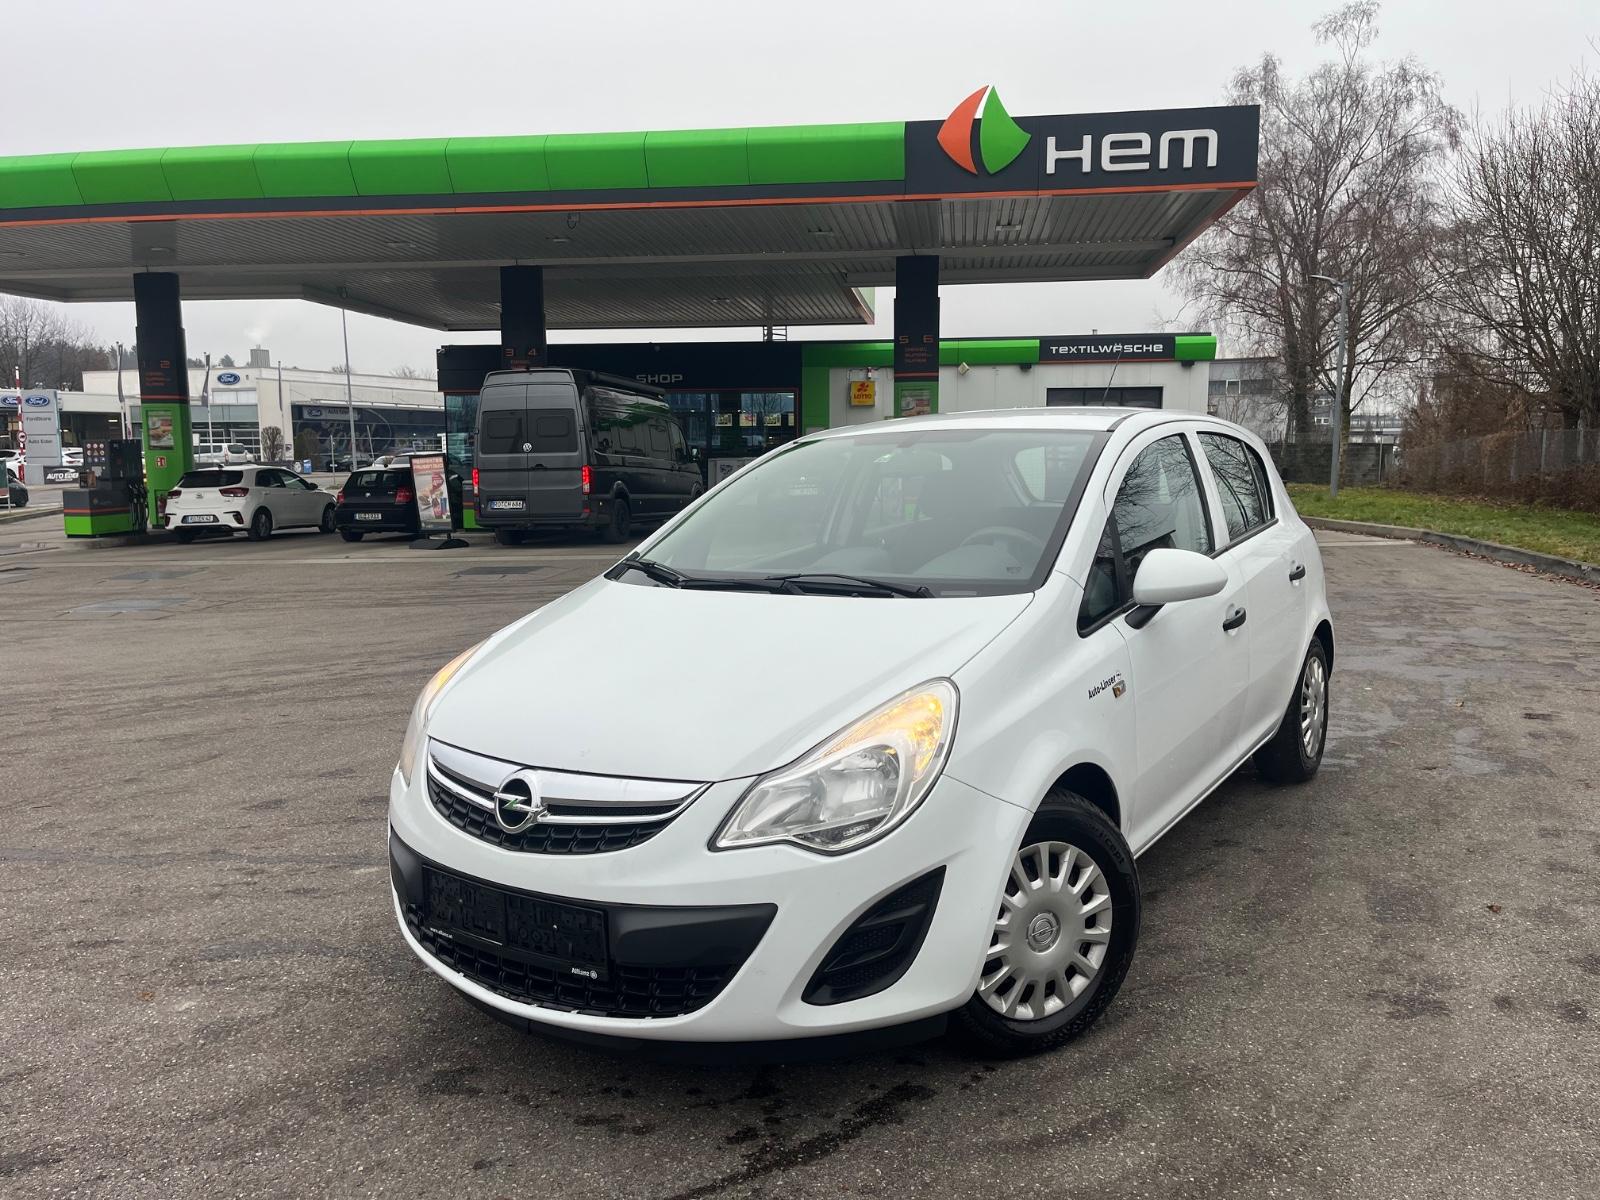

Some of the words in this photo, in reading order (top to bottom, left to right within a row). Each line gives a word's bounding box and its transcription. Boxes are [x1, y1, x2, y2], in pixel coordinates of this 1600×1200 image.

[504, 348, 514, 357] 3
[528, 347, 538, 356] 4
[636, 374, 683, 384] SHOP
[853, 392, 872, 400] LOTTO
